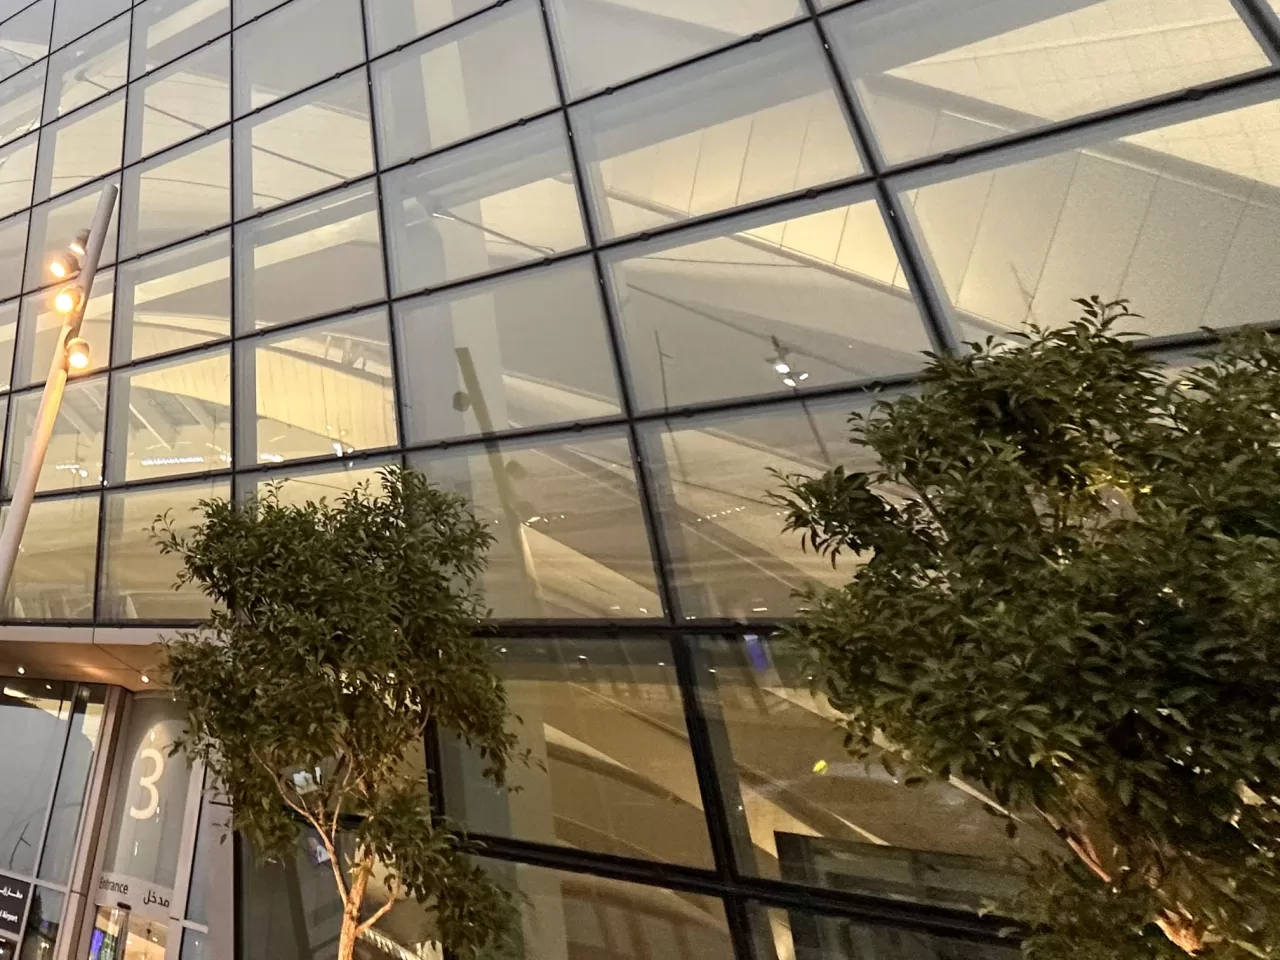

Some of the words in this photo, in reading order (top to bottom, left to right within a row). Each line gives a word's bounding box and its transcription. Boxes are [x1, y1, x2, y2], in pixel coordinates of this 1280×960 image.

[130, 748, 164, 819] 3
[99, 876, 129, 894] Entrance
[143, 889, 170, 908] مدخل
